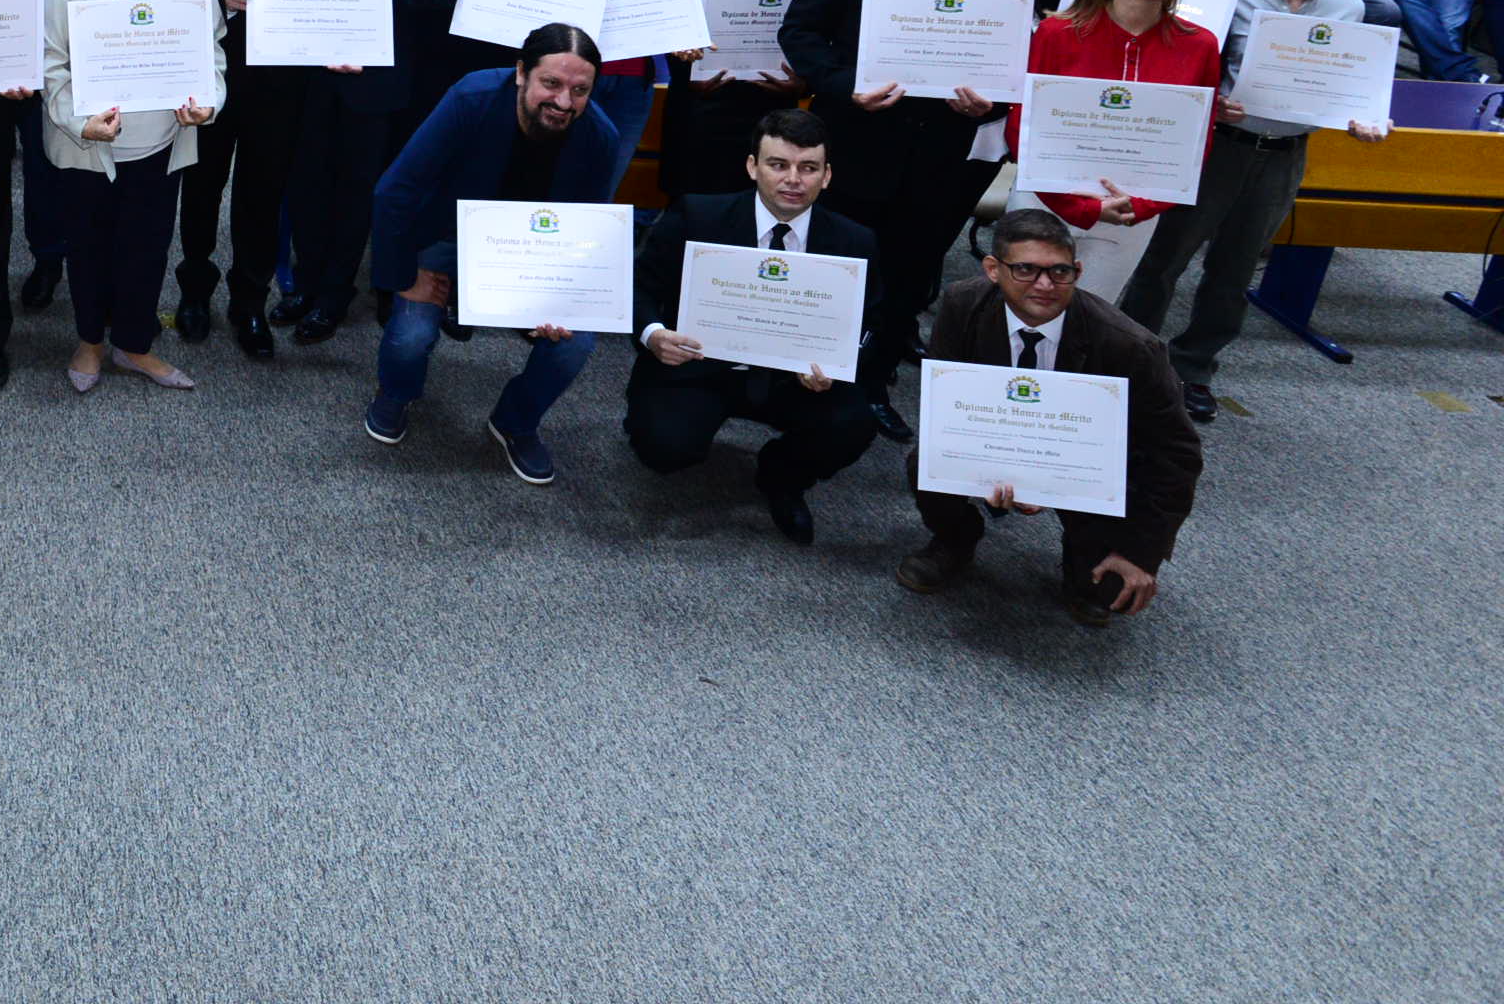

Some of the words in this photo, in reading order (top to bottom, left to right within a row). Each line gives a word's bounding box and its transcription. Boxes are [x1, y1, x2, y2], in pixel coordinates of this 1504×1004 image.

[721, 11, 749, 19] Diploma
[890, 14, 924, 24] Diploma
[925, 16, 935, 24] de
[937, 16, 963, 26] Honra
[976, 19, 1005, 28] Mérito
[94, 31, 122, 41] Diploma
[133, 30, 155, 38] Honra
[167, 28, 190, 36] Mérito
[1051, 108, 1087, 119] Diploma
[1089, 112, 1100, 120] de
[1102, 112, 1130, 123] Honra
[1146, 117, 1176, 126] Mérito
[711, 277, 745, 290] Diploma
[748, 283, 757, 291] de
[761, 284, 787, 295] Honra
[803, 289, 832, 300] Mérito
[954, 400, 994, 413] Diploma
[997, 405, 1007, 415] de
[1011, 406, 1041, 418] Honra
[1059, 412, 1092, 423] Mérito
[967, 415, 996, 424] Câmara
[998, 418, 1036, 428] Municipal
[1048, 424, 1078, 433] Goiânia
